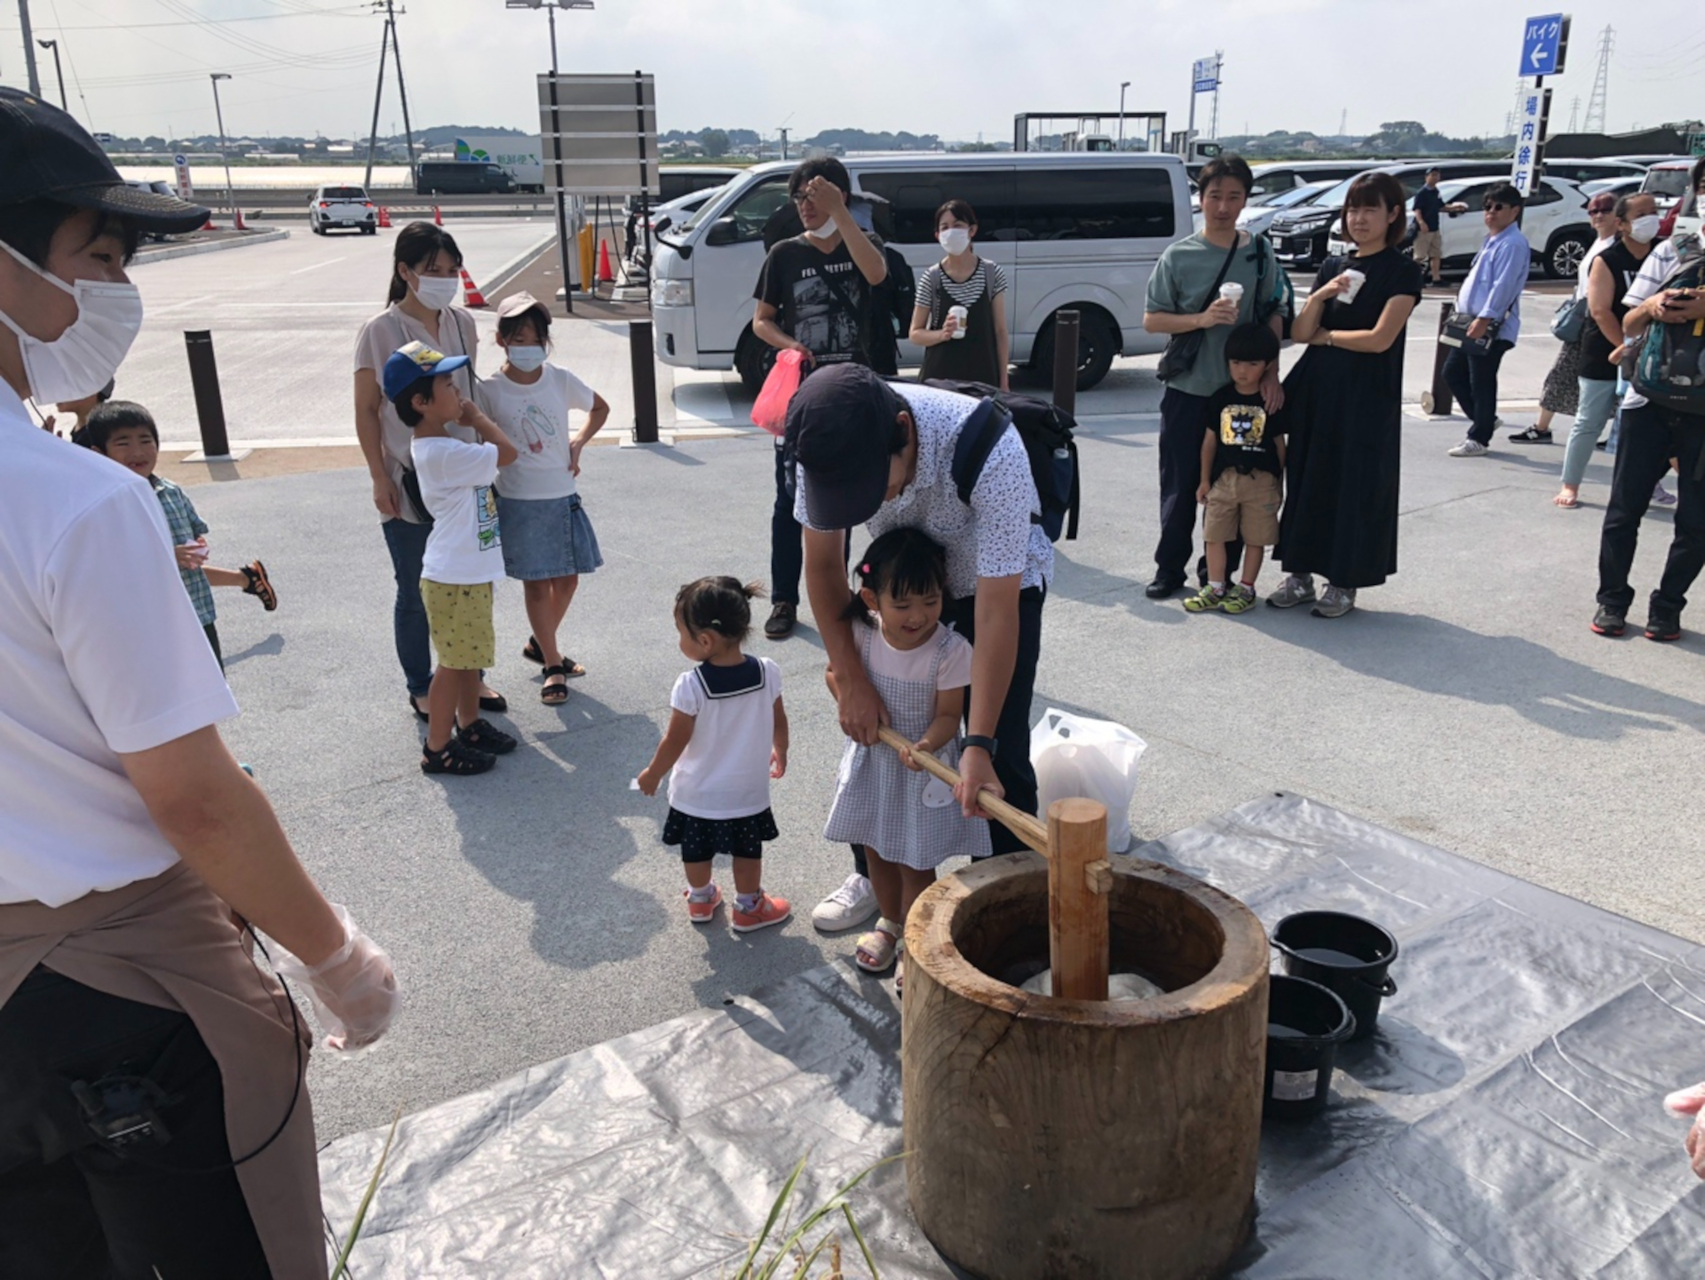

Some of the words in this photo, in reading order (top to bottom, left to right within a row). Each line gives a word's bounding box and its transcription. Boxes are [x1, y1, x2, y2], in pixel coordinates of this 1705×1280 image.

[1526, 22, 1559, 40] バイク
[1515, 96, 1537, 189] 場内徐行
